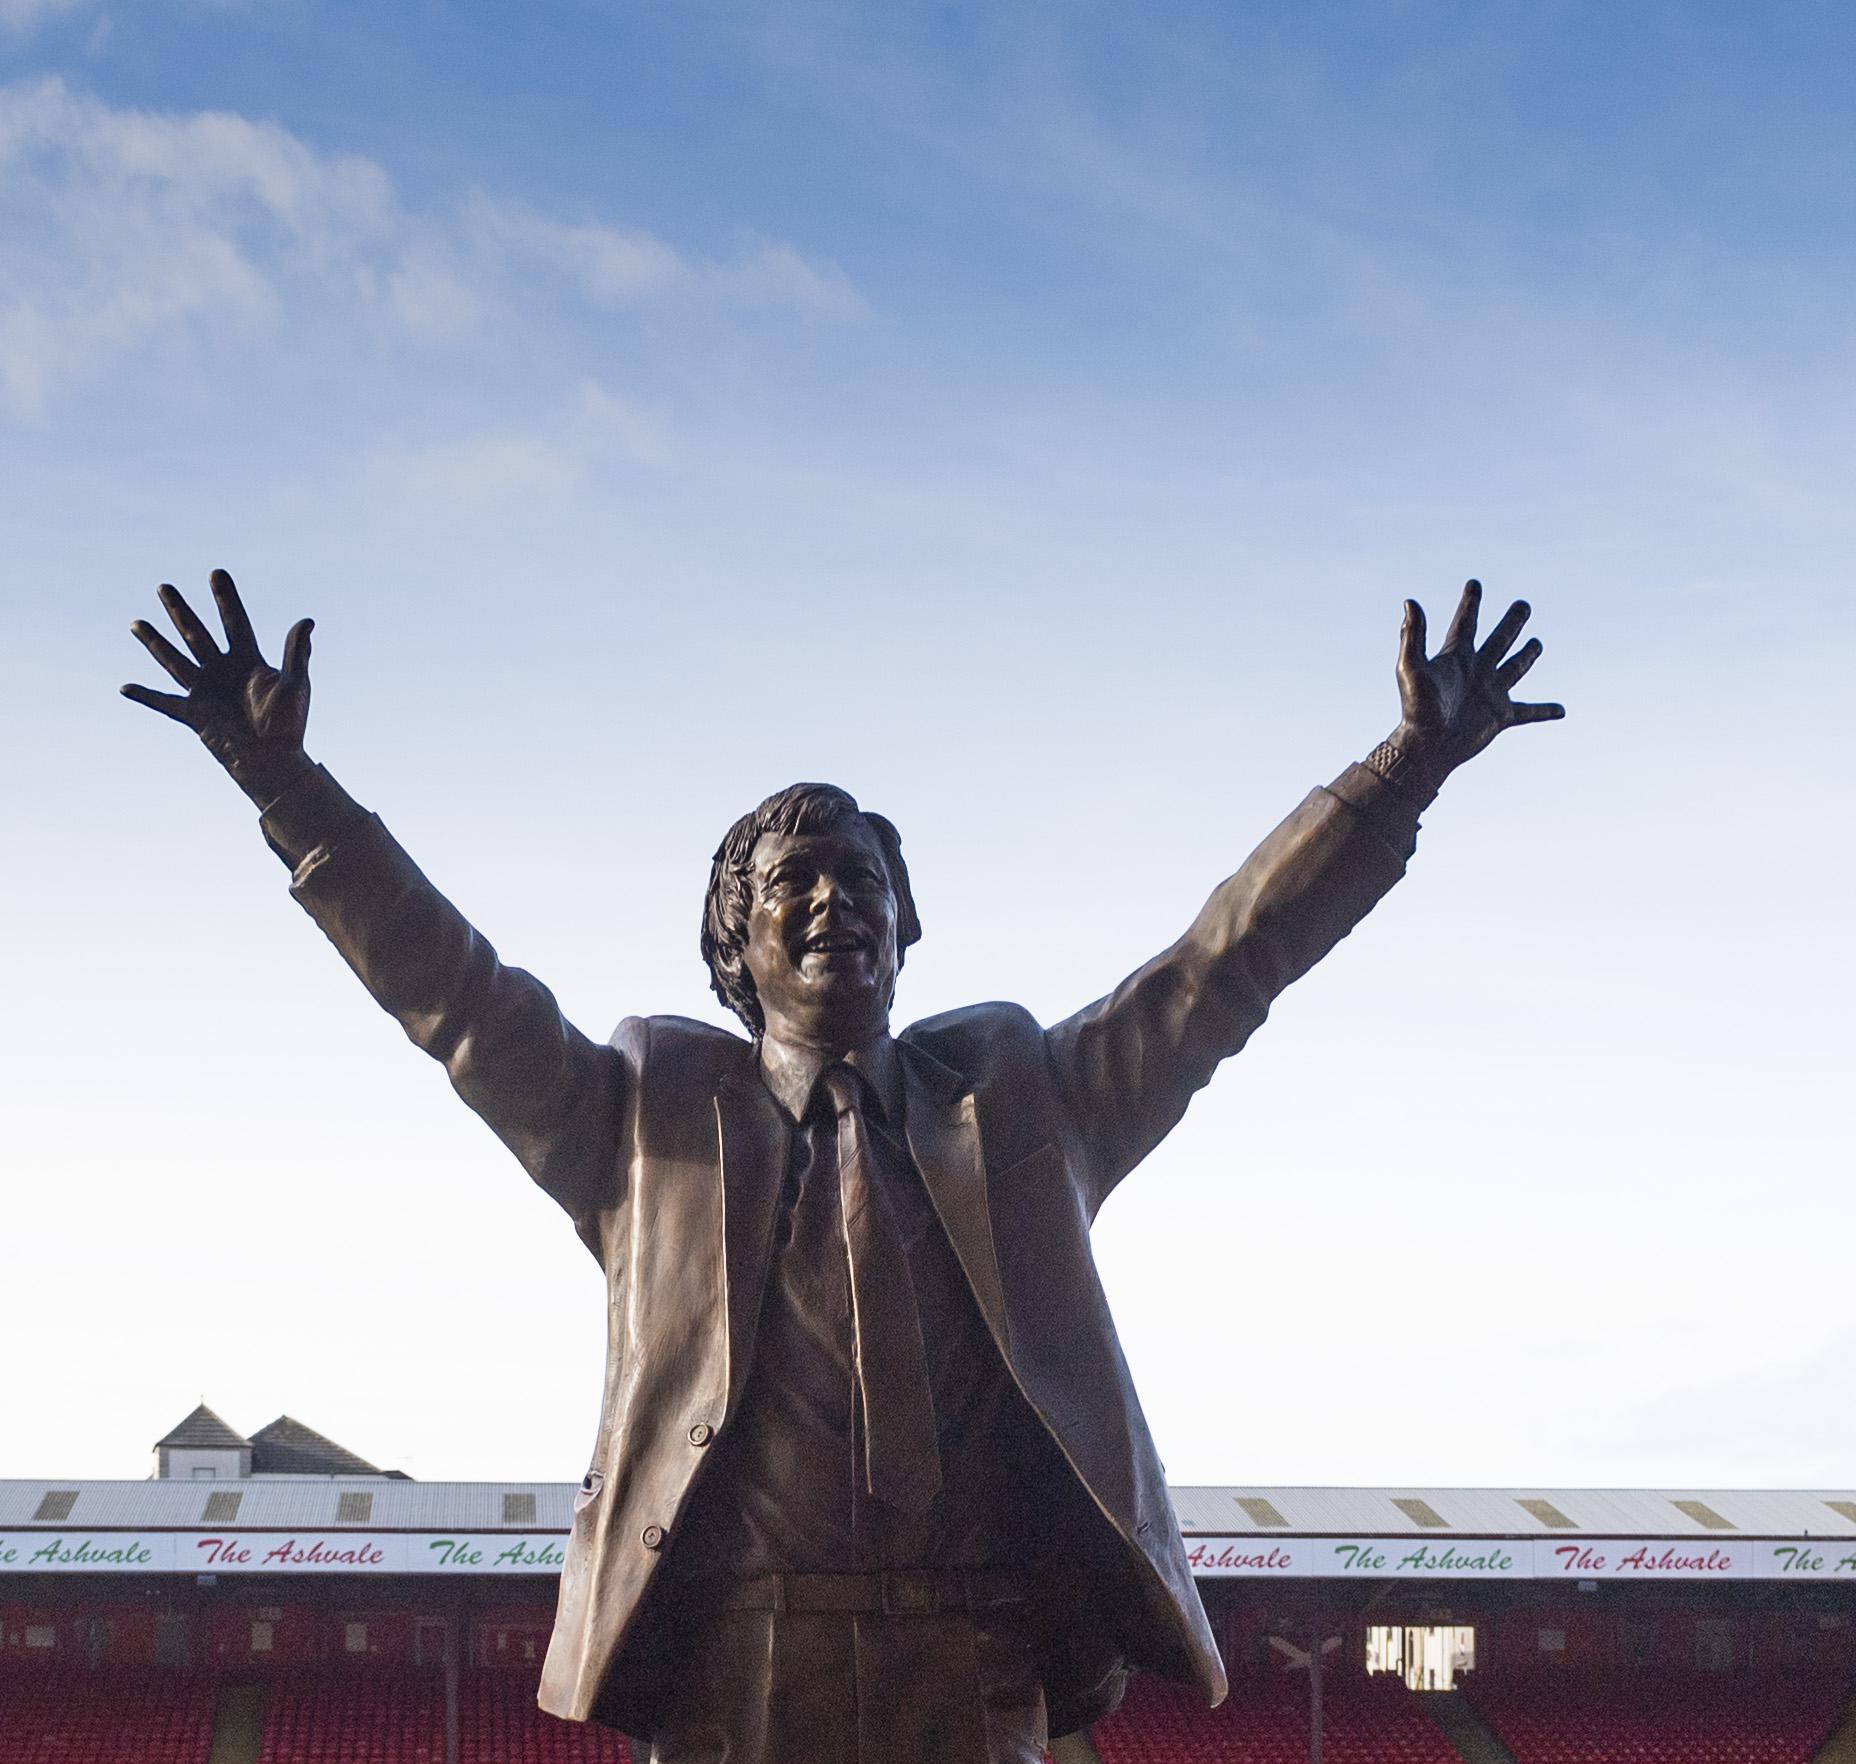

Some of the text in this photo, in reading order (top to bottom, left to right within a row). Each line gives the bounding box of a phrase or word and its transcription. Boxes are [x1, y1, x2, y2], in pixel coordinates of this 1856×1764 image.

[28, 1539, 152, 1564] Ashvale
[197, 1540, 384, 1565] The Ashvale
[429, 1540, 565, 1566] The Ashv
[1335, 1545, 1513, 1570] The Ashvale
[1555, 1546, 1732, 1571] The Ashvale
[1774, 1547, 1824, 1571] The
